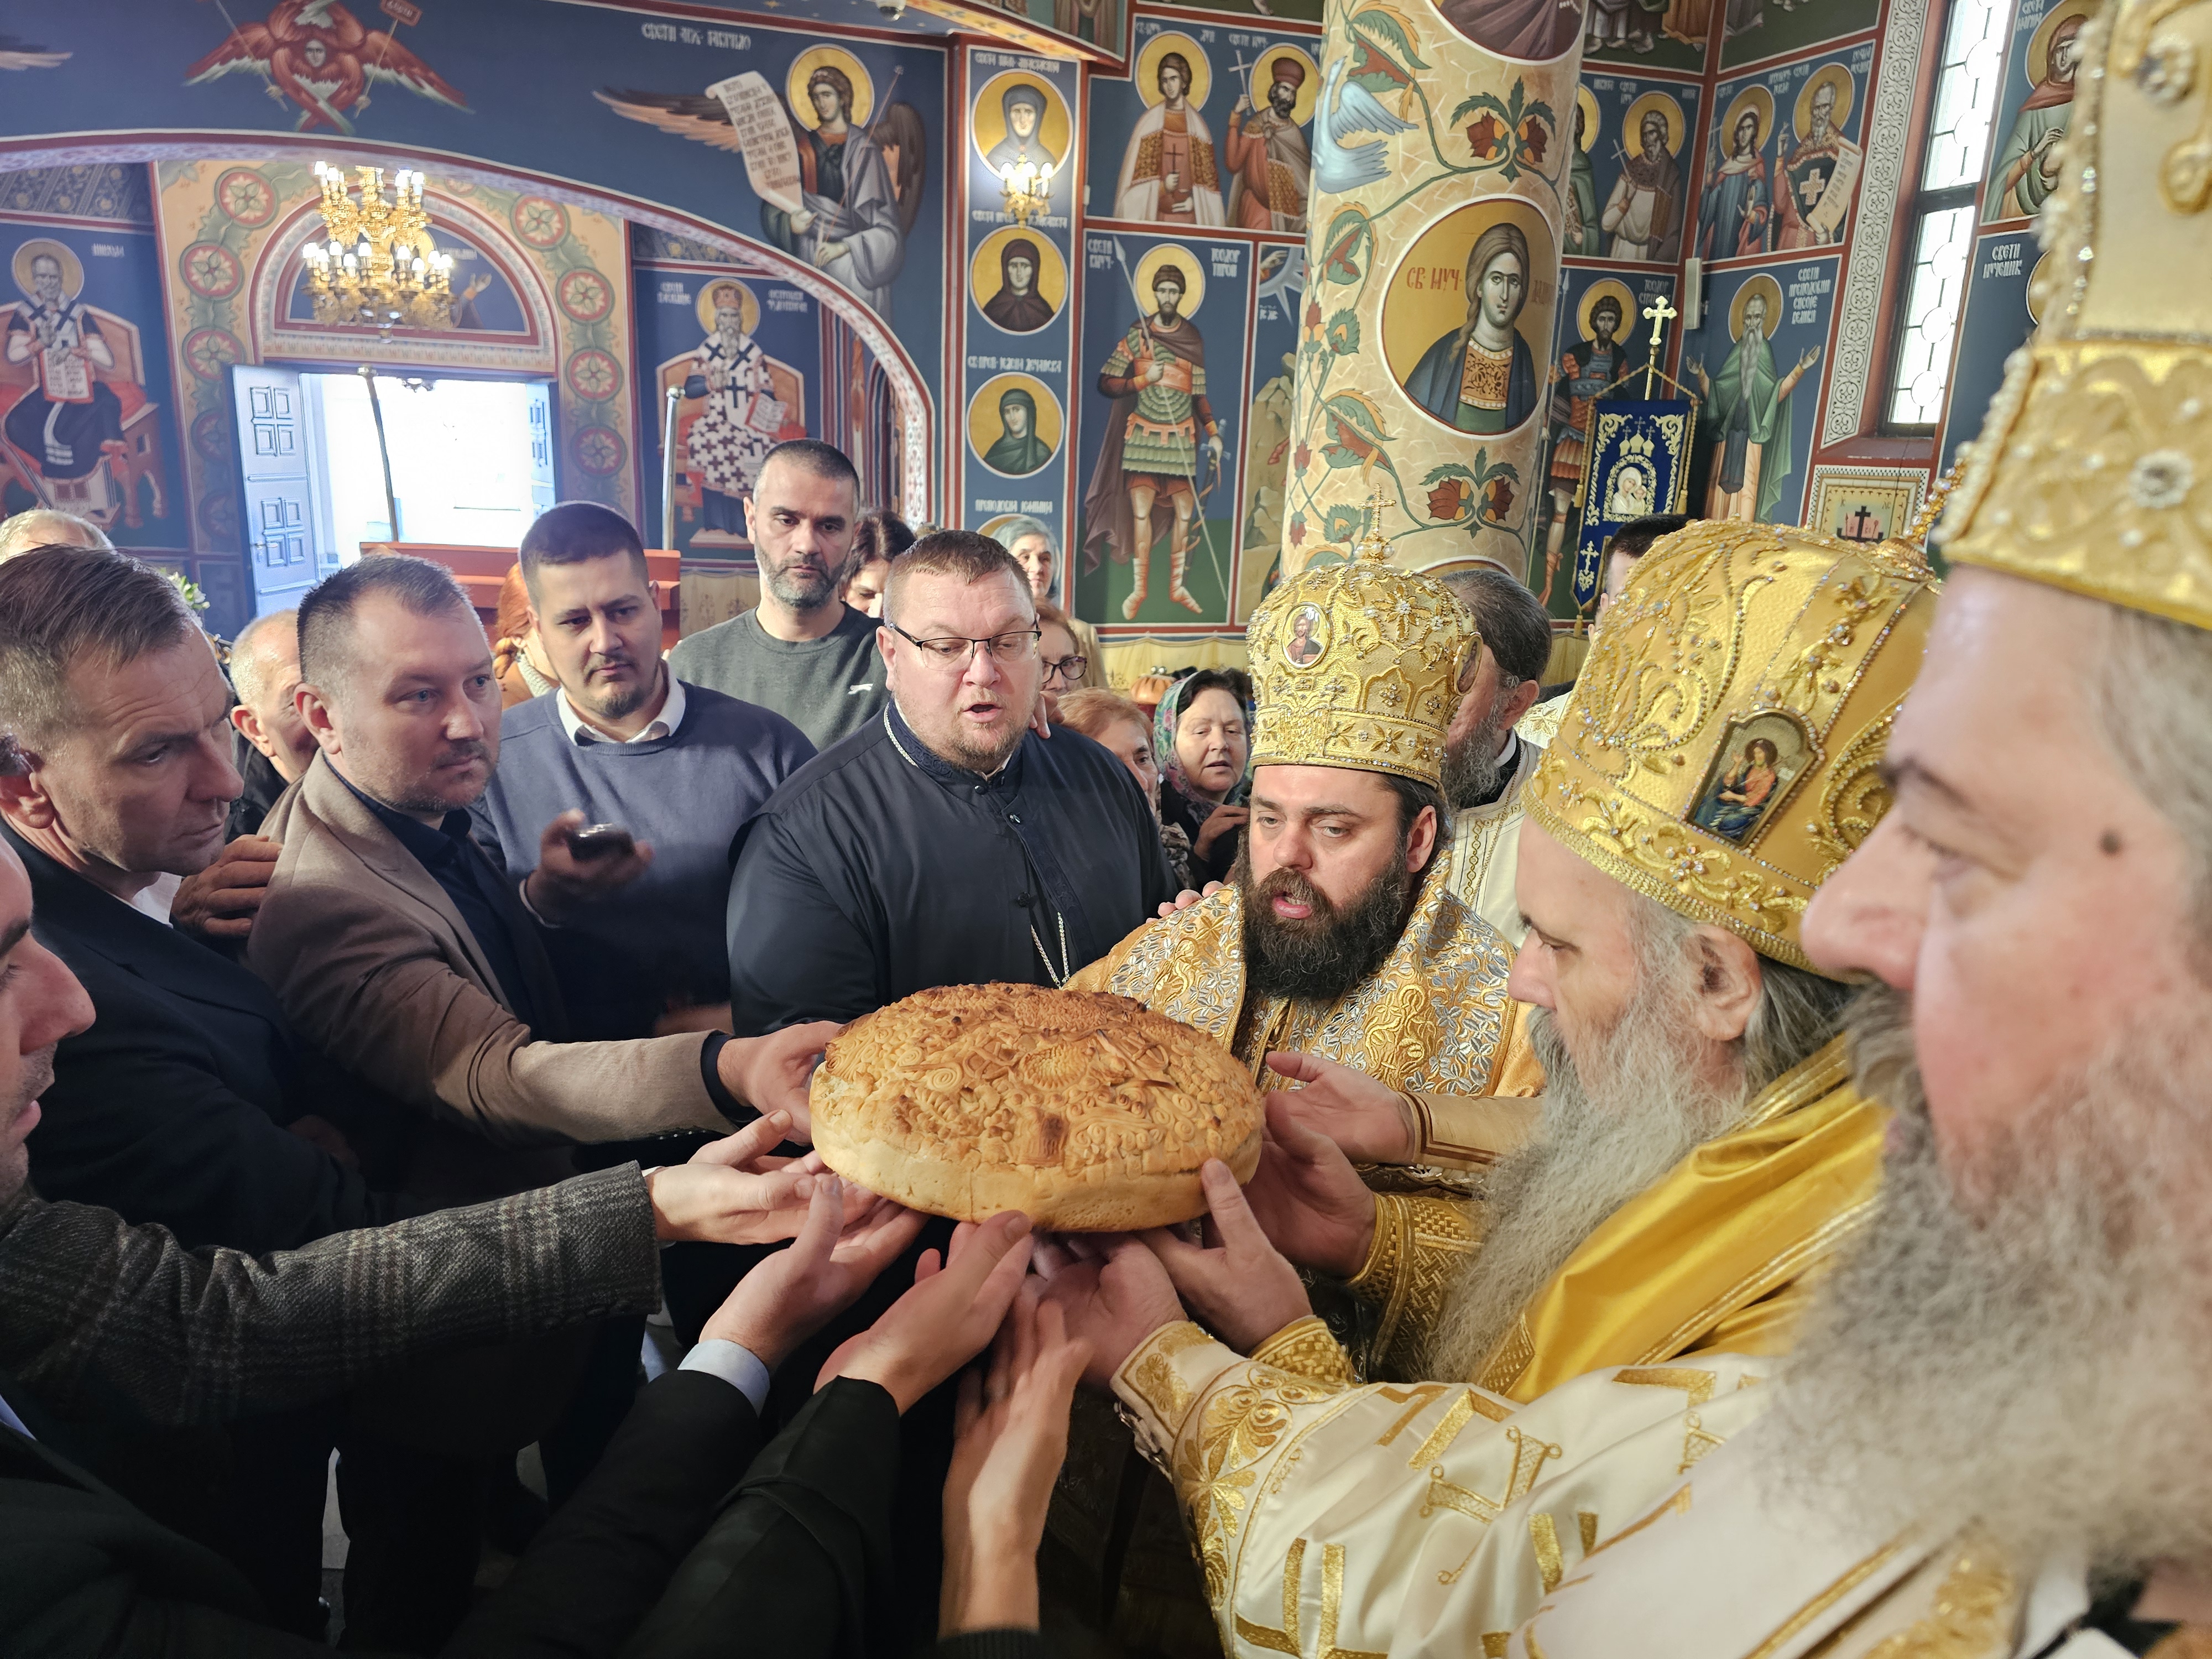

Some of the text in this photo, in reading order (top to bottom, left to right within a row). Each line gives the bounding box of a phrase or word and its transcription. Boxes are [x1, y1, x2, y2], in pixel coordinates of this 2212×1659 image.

[1992, 243, 2020, 260] СВЕТИ
[1798, 267, 1820, 281] СВЕТИ
[1983, 259, 2022, 279] МУЧЕНИК
[1793, 295, 1818, 310] СИСОЈЕ
[1792, 310, 1817, 325] ВЕЛИКИ
